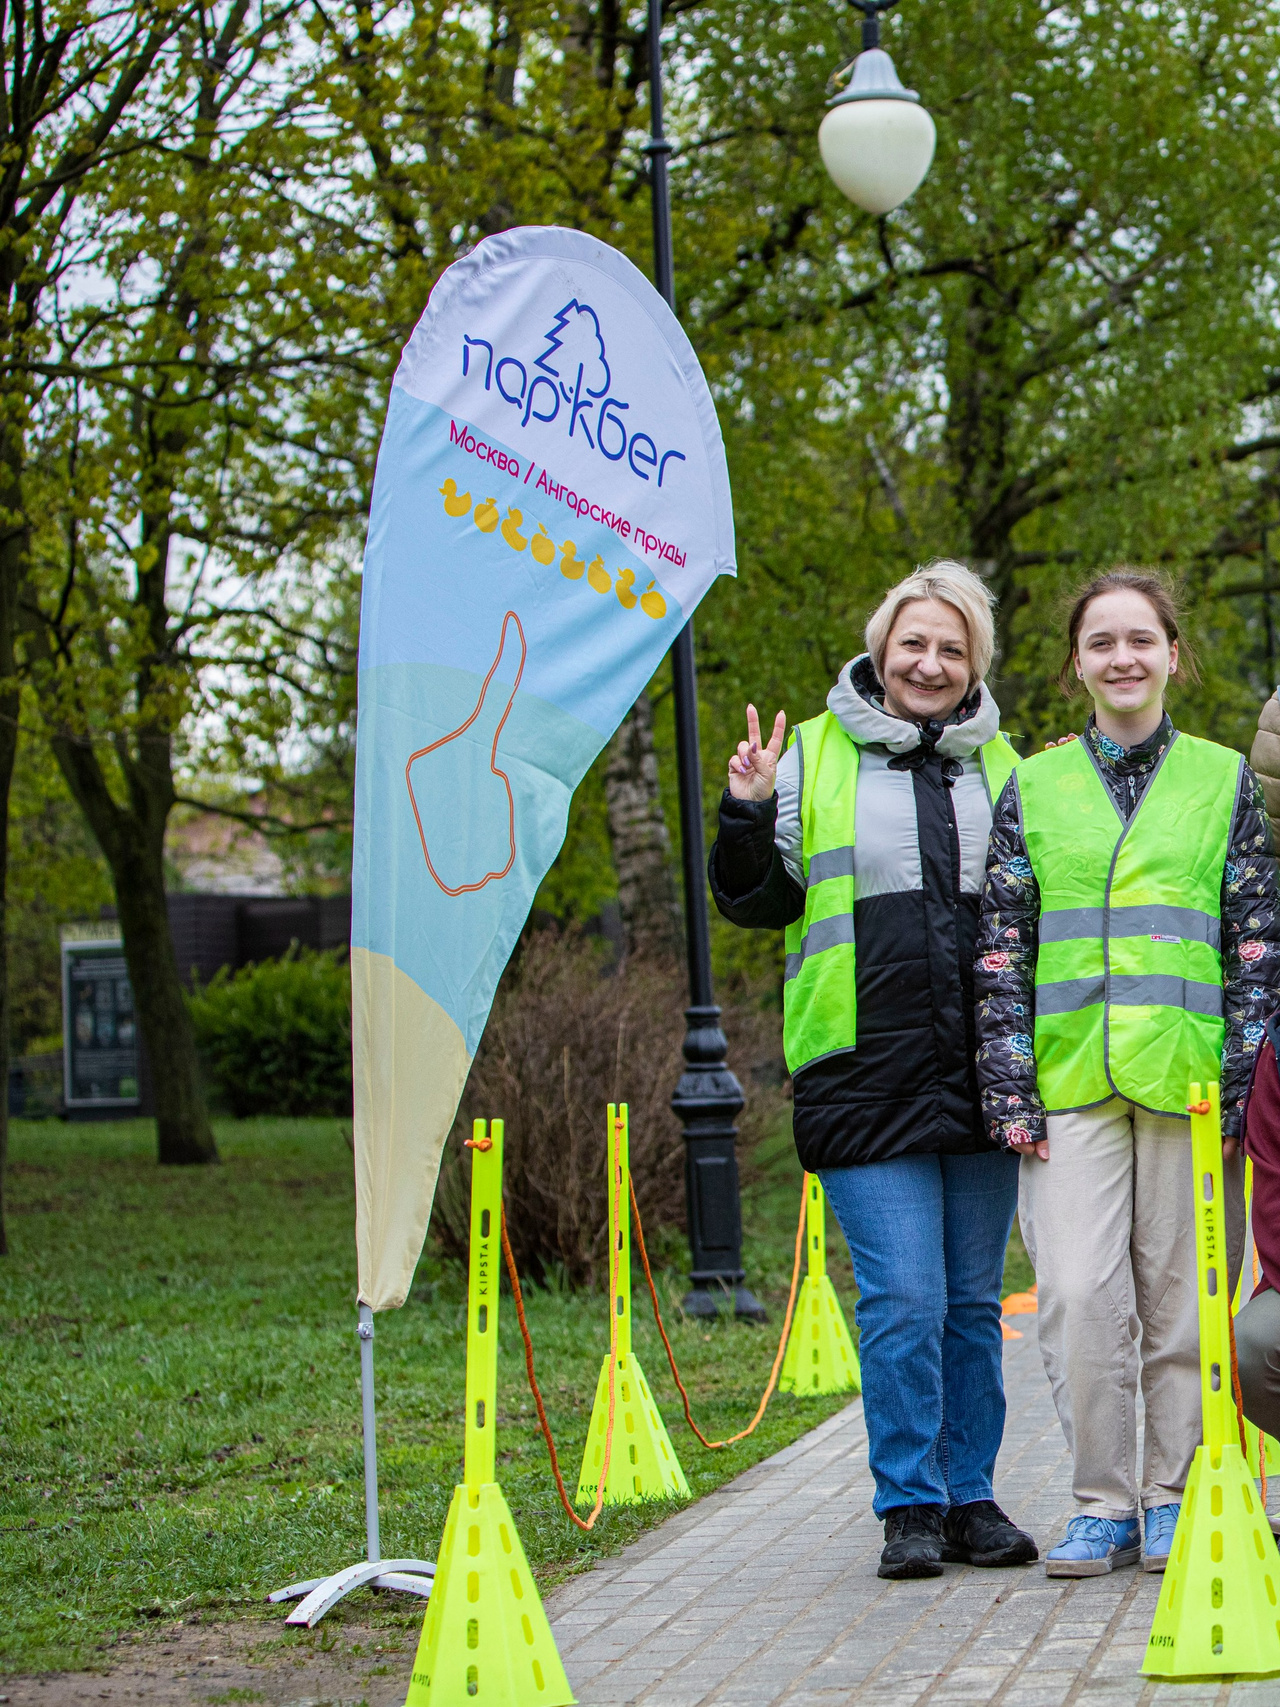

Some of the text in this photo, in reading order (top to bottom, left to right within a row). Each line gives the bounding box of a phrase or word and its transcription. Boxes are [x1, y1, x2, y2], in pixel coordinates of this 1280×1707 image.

[449, 420, 687, 568] Москва / Ангарские пруды
[1204, 1207, 1216, 1260] KIPSTA
[479, 1243, 489, 1295] KIPSTA
[579, 1484, 608, 1493] KIPSA
[1149, 1634, 1174, 1647] KIPSTA
